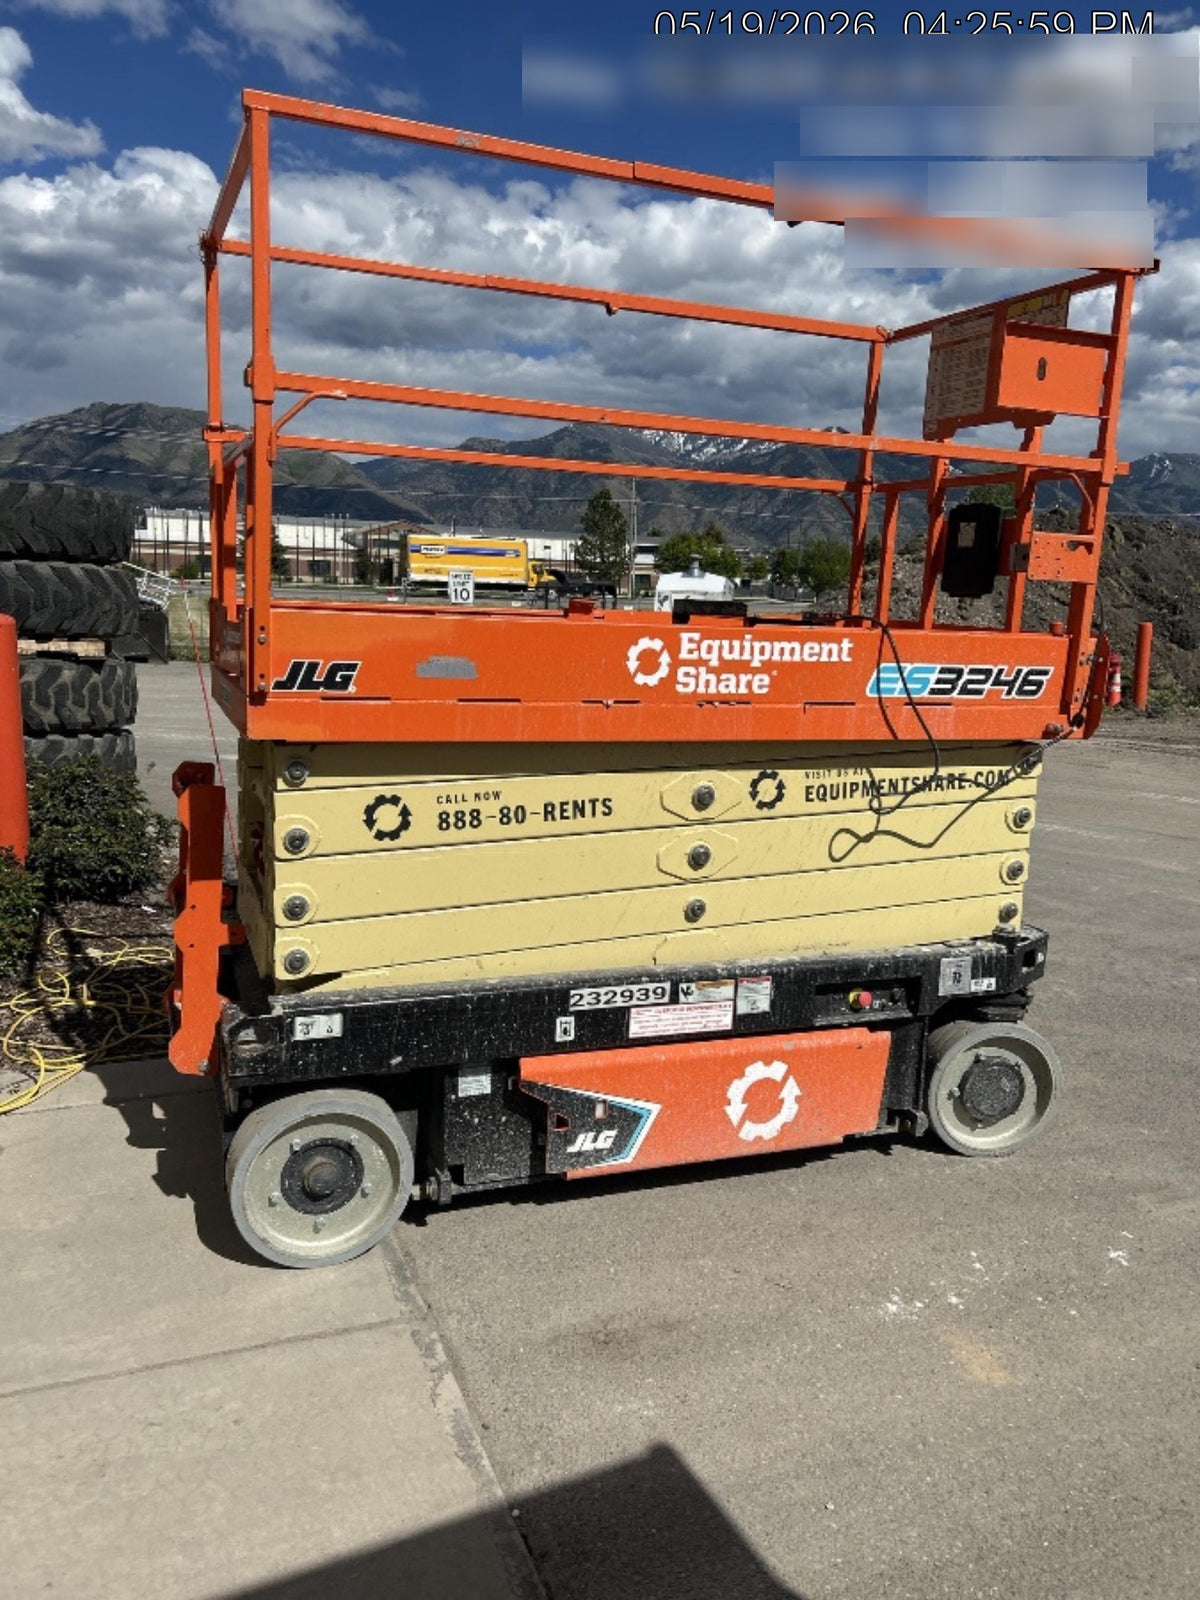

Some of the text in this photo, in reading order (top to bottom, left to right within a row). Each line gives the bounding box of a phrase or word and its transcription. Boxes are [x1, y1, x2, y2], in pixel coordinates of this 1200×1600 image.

[453, 588, 470, 601] 10
[678, 632, 854, 667] Equipment
[270, 659, 362, 693] JLG
[675, 666, 771, 694] Share
[866, 663, 1055, 699] ES3246
[804, 769, 832, 780] VISIT
[436, 790, 502, 805] CALL NOW
[437, 797, 613, 831] 888-80-RENTS
[570, 985, 668, 1008] 232939
[565, 1129, 619, 1153] JLG
